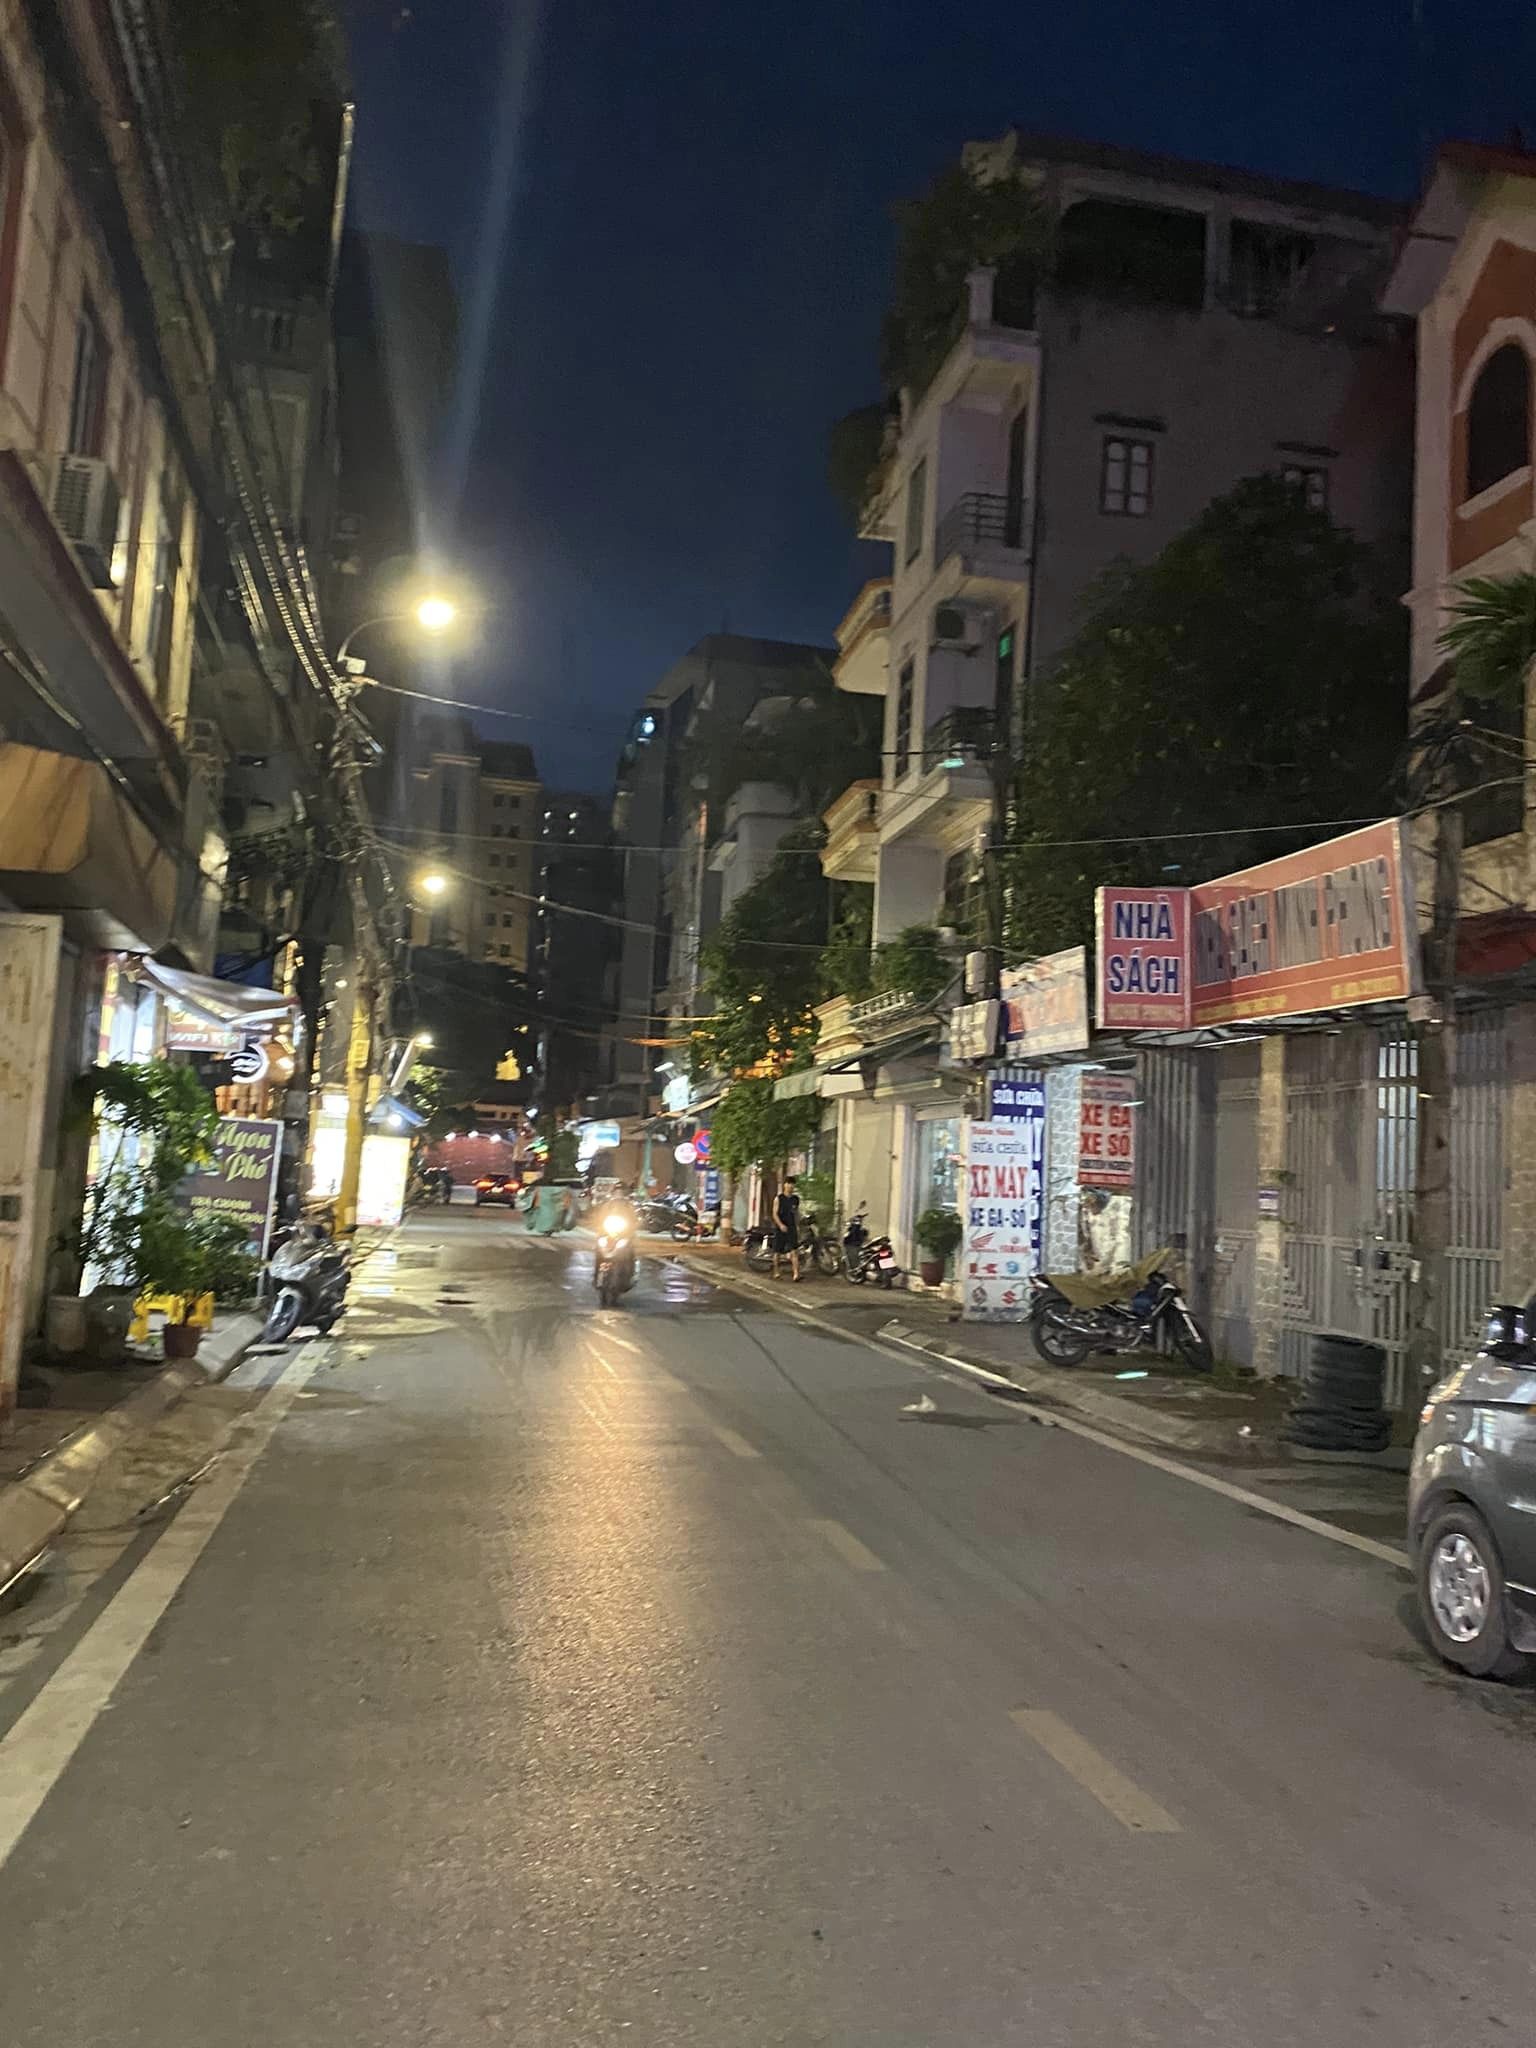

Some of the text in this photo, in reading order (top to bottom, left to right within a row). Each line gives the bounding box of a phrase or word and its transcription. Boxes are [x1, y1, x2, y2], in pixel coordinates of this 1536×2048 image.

[1112, 894, 1177, 941] NHÀ
[1107, 946, 1182, 996] SÁCH
[1081, 1104, 1132, 1128] XE GA
[1081, 1132, 1102, 1154] XE
[970, 1164, 991, 1198] XE
[994, 1156, 1028, 1198] MÁY
[970, 1207, 985, 1227] XE
[988, 1207, 1003, 1227] GA
